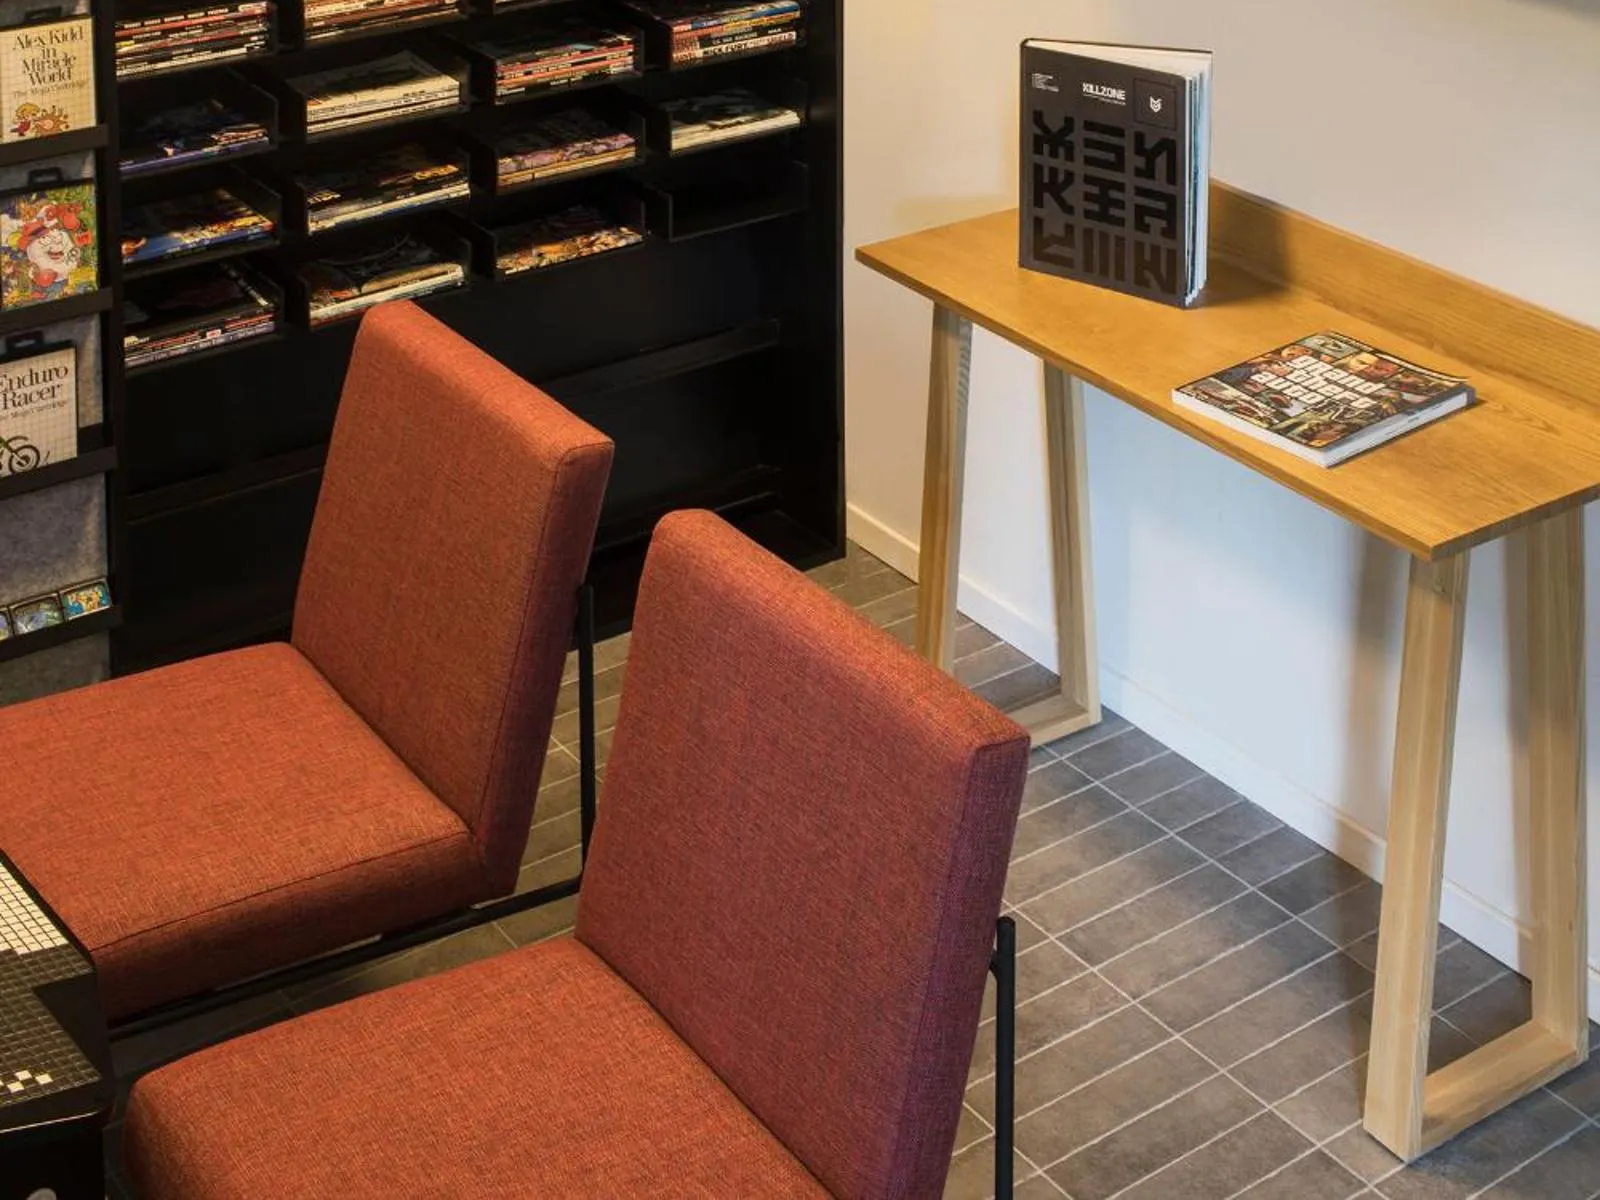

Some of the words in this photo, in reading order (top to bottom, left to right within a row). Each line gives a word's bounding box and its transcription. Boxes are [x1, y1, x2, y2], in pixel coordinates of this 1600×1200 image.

[12, 34, 46, 50] Alex
[49, 26, 83, 45] Kidd
[23, 52, 76, 74] Miracle
[41, 47, 57, 60] in
[29, 67, 72, 86] World
[1082, 82, 1126, 100] KILLZONE
[3, 384, 64, 410] Racer
